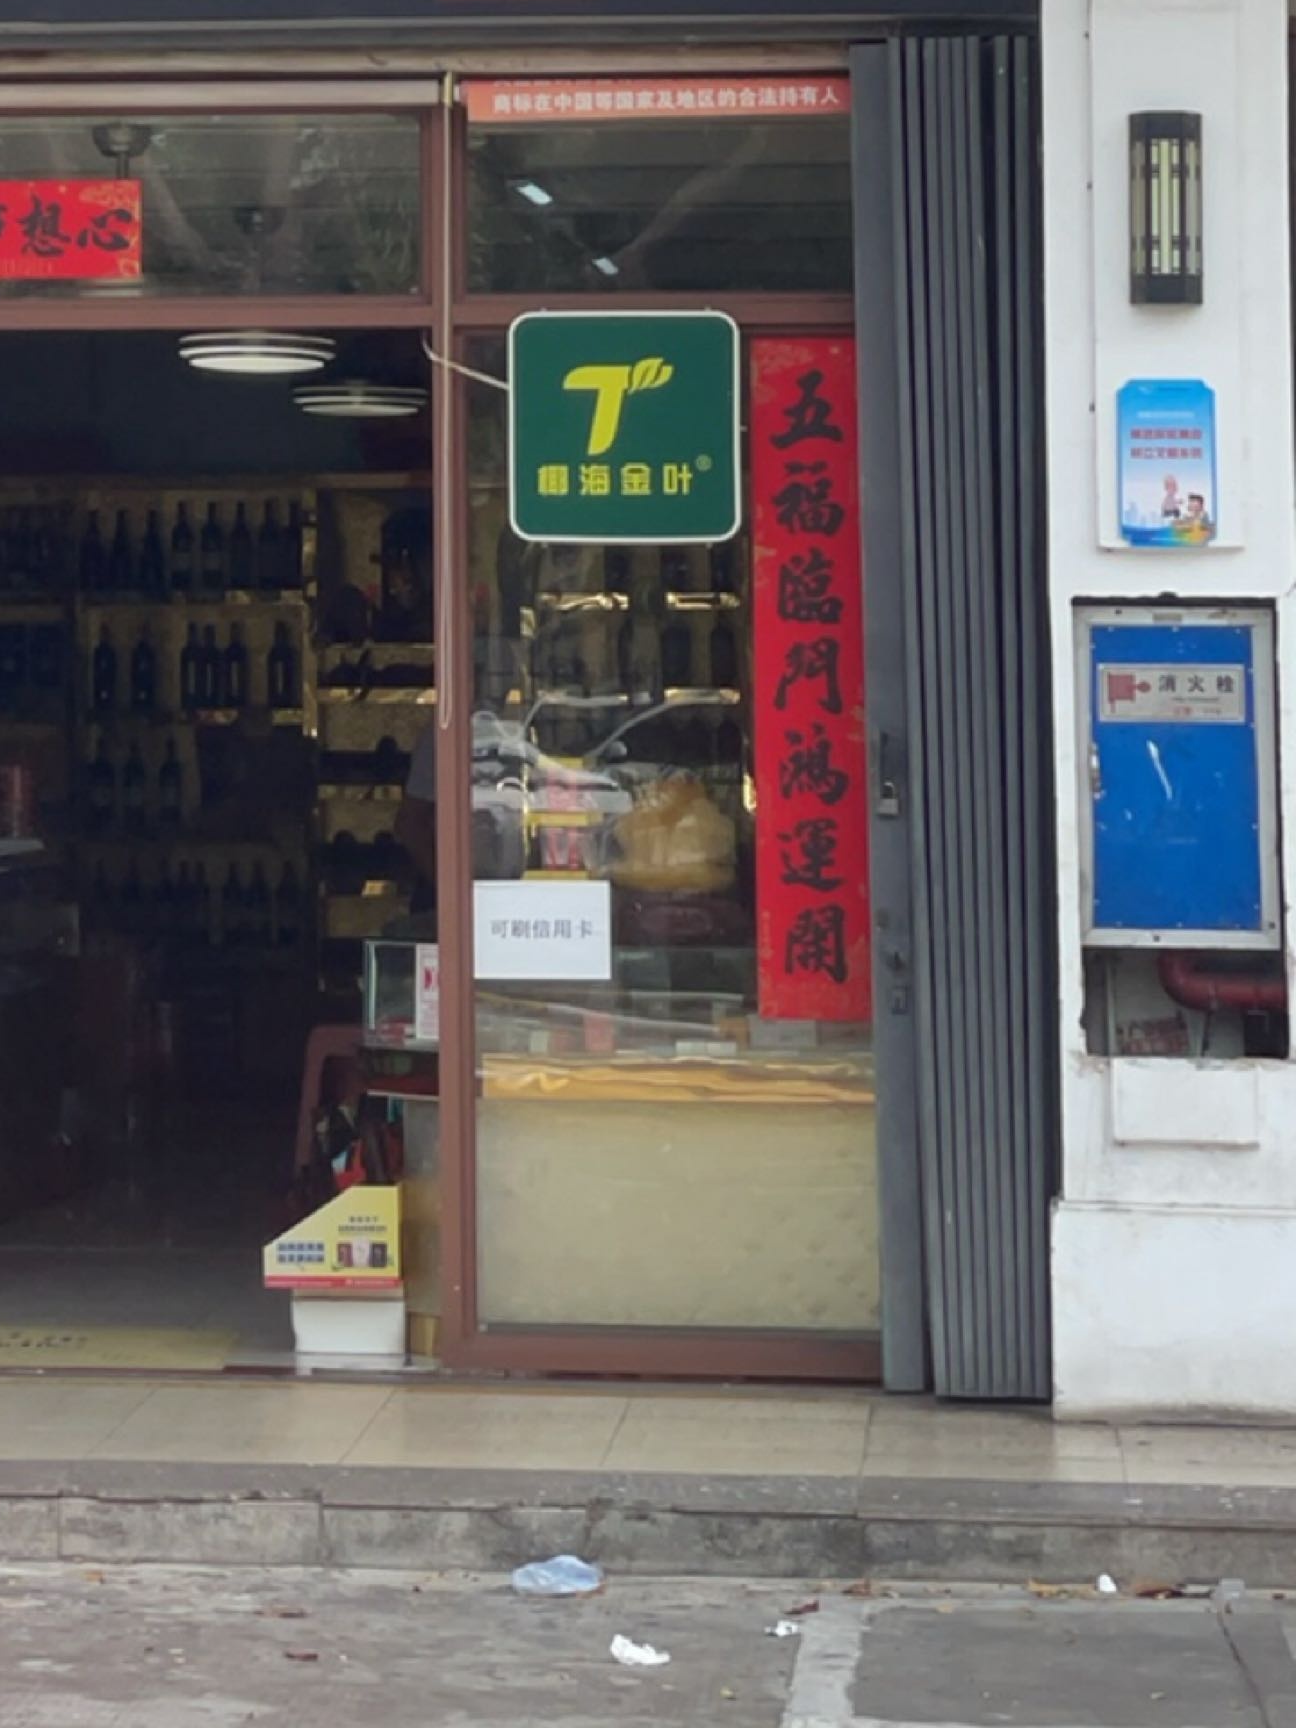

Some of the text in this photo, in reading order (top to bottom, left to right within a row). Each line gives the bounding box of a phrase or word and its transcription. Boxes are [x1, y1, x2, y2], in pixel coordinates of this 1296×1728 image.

[490, 918, 594, 940] 可刷信用卡
